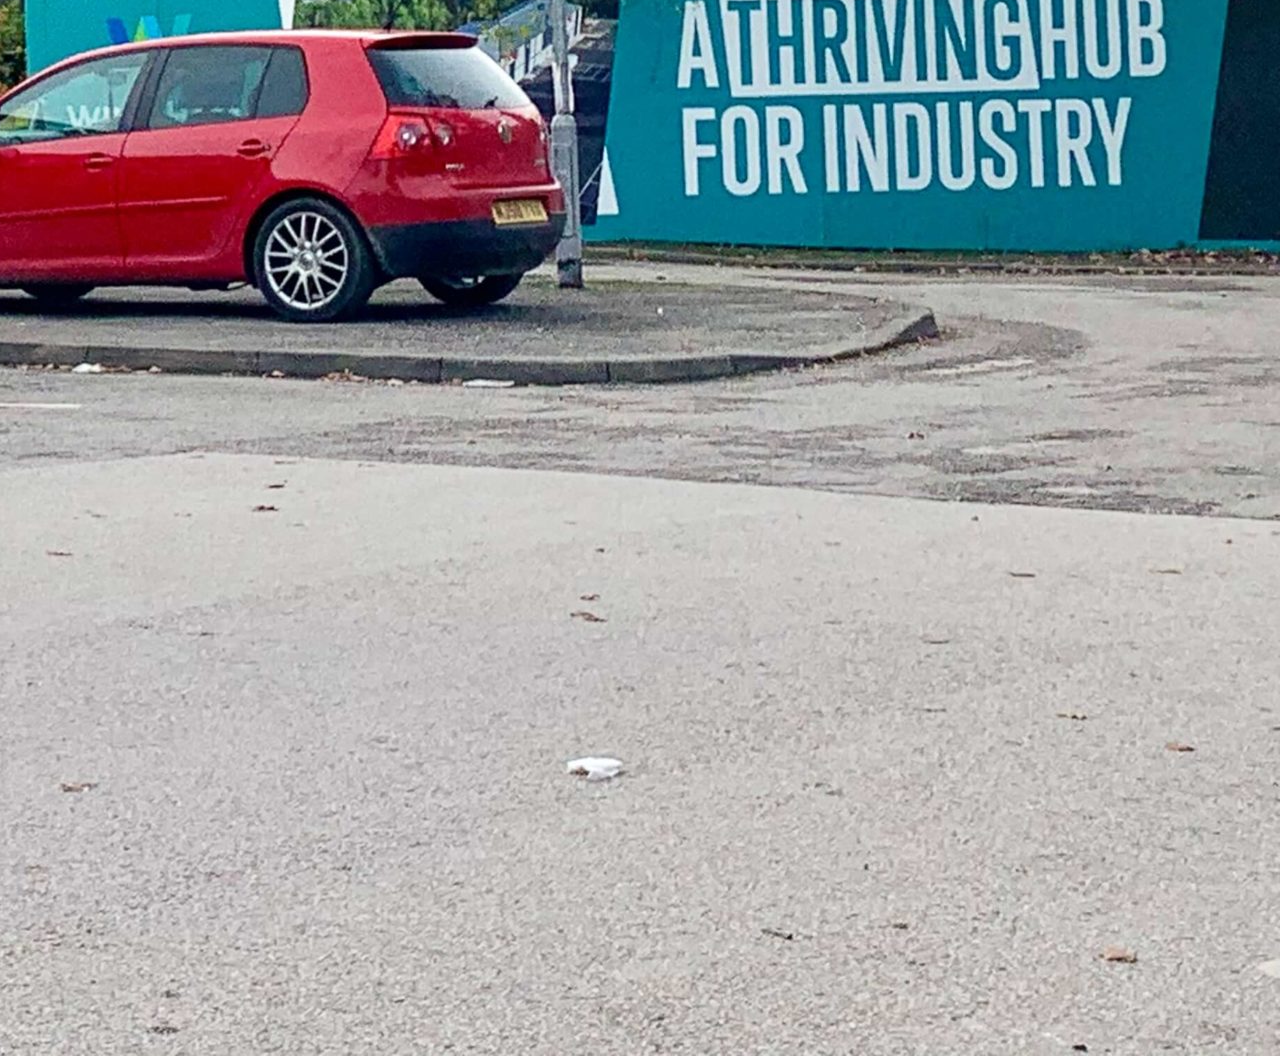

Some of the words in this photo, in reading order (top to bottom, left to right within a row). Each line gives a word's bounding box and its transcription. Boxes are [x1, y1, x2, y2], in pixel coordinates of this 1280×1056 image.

[677, 0, 719, 89] A
[681, 104, 808, 196] FOR
[822, 96, 1132, 192] INDUSTRY
